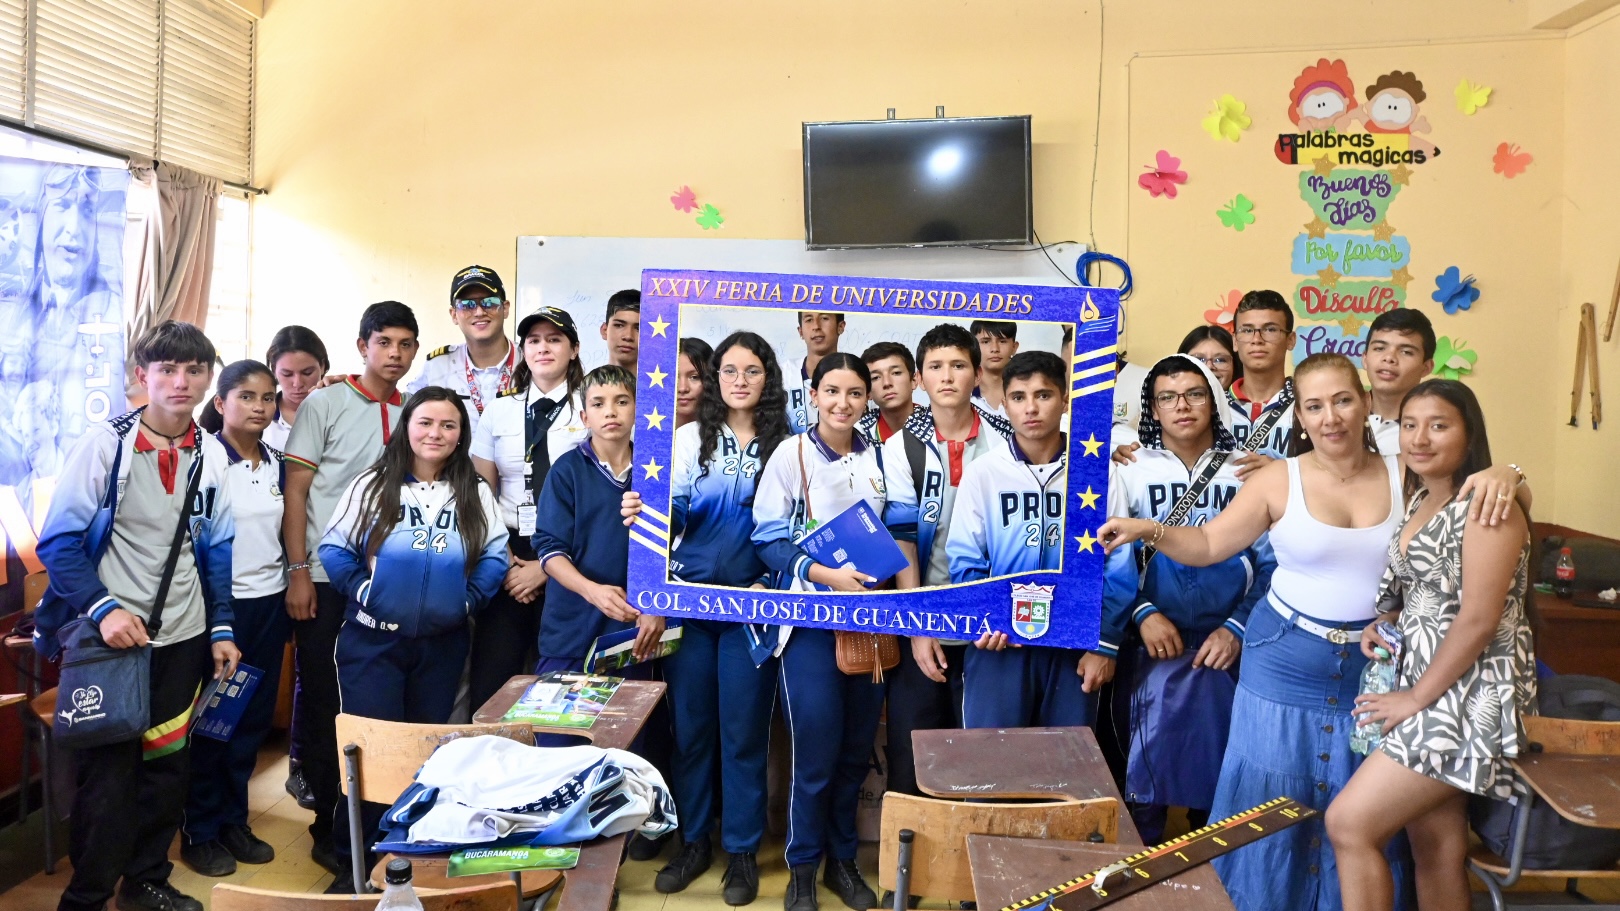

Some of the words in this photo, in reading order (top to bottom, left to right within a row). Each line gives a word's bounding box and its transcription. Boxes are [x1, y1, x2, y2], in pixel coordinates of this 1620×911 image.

[1338, 147, 1427, 167] magicas
[648, 277, 710, 298] XXIV
[714, 280, 784, 303] FERIA
[790, 284, 824, 305] DE
[831, 286, 1034, 315] UNIVERSIDADES
[82, 362, 111, 424] OL
[723, 458, 756, 478] 24
[1001, 492, 1063, 528] PRO
[411, 529, 448, 554] 24
[1026, 523, 1061, 548] 24
[637, 590, 691, 612] COL.
[699, 594, 745, 616] SAN
[747, 598, 806, 621] JOSÉ
[814, 605, 846, 624] DE
[852, 608, 991, 636] GUANENTÁ
[464, 850, 529, 859] BUCARAMANGA
[1174, 850, 1190, 864] 7
[1212, 836, 1229, 847] 8
